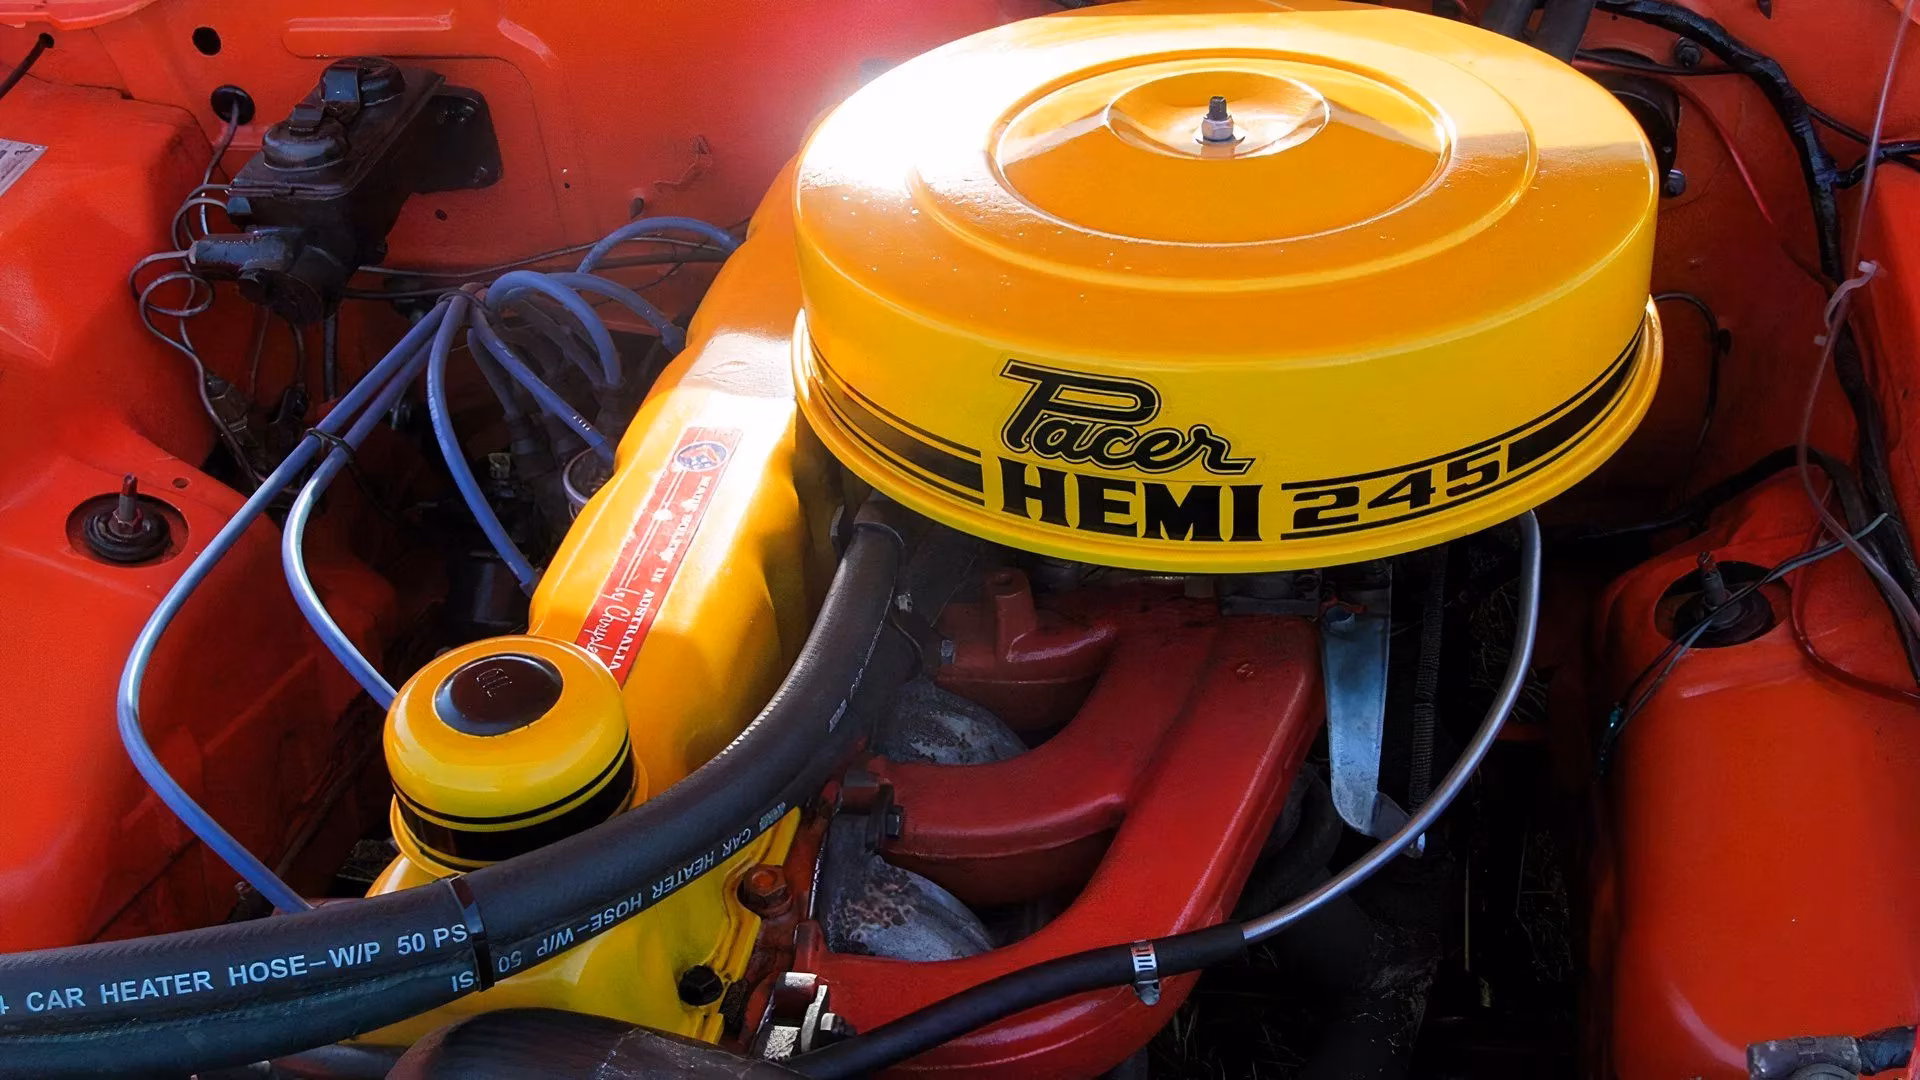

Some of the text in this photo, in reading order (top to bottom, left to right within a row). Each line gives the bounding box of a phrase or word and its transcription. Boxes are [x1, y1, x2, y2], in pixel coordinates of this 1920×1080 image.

[999, 359, 1256, 475] Pacer
[997, 445, 1501, 541] HEMI 245
[651, 567, 668, 582] IN
[584, 605, 631, 653] Chrysle
[609, 588, 655, 669] AUSTRALIA
[722, 828, 751, 857] CAR
[652, 851, 714, 899] HEATER
[26, 987, 86, 1012] CAR
[100, 970, 214, 1004] HEATER
[397, 932, 426, 955] 50
[432, 923, 468, 948] PS
[452, 970, 480, 992] SI
[499, 951, 521, 972] 50
